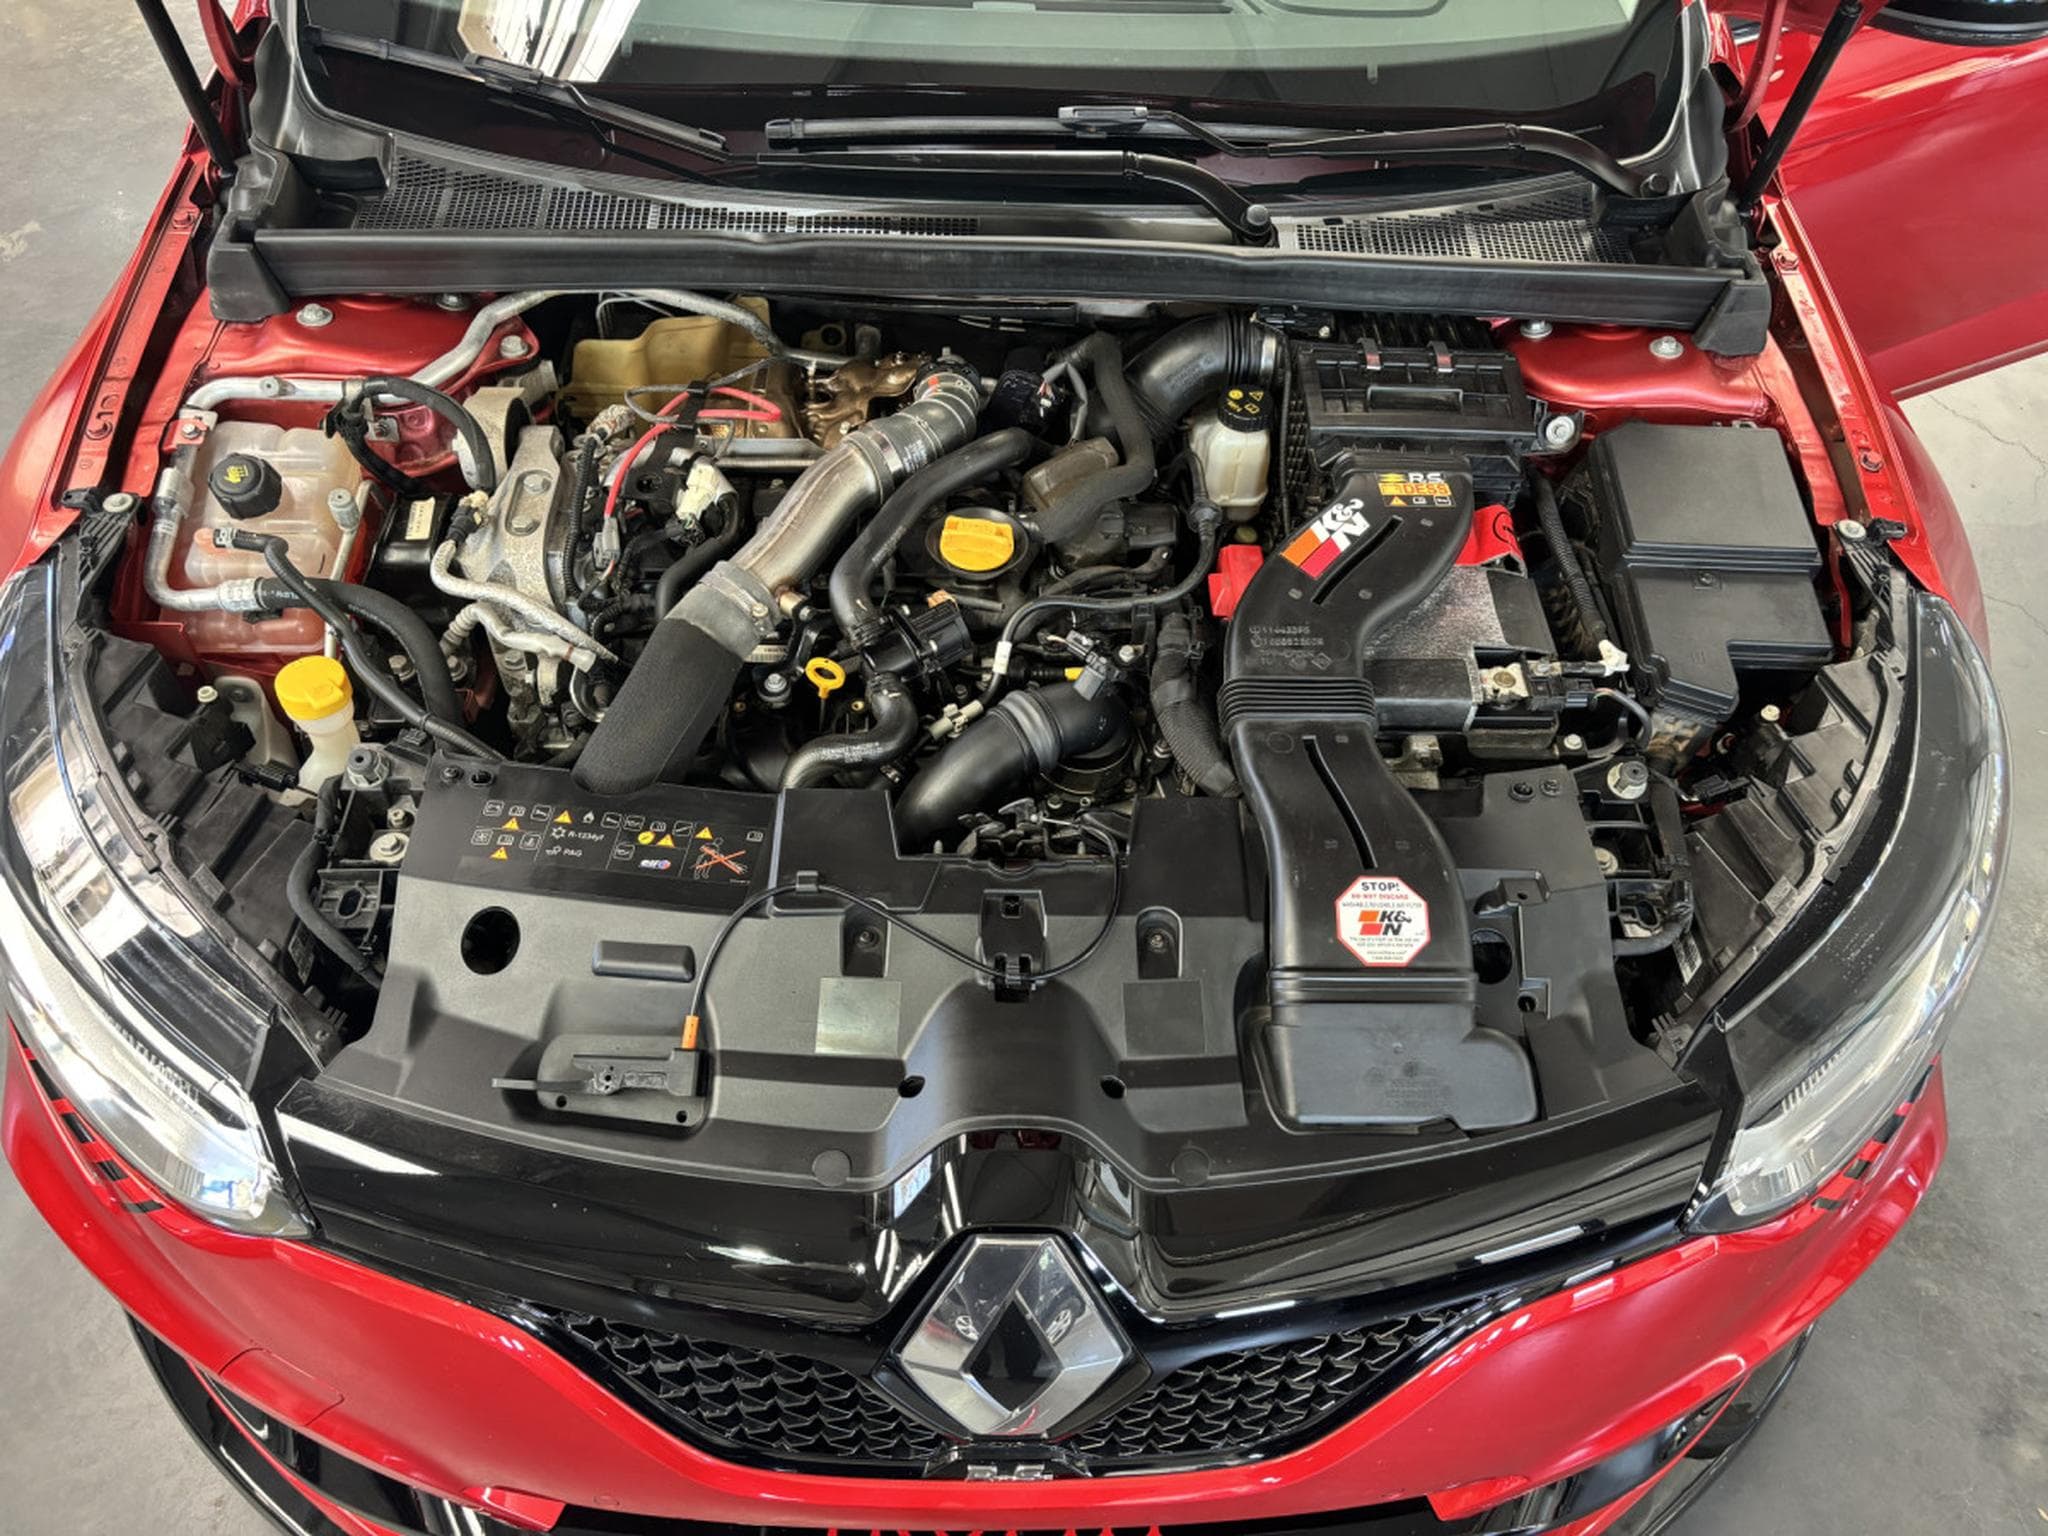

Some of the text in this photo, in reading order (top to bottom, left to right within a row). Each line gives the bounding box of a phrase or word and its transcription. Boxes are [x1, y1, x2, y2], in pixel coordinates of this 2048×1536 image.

[1403, 483, 1449, 495] DESS
[1361, 882, 1400, 892] STOP!
[1379, 910, 1412, 936] K&N
